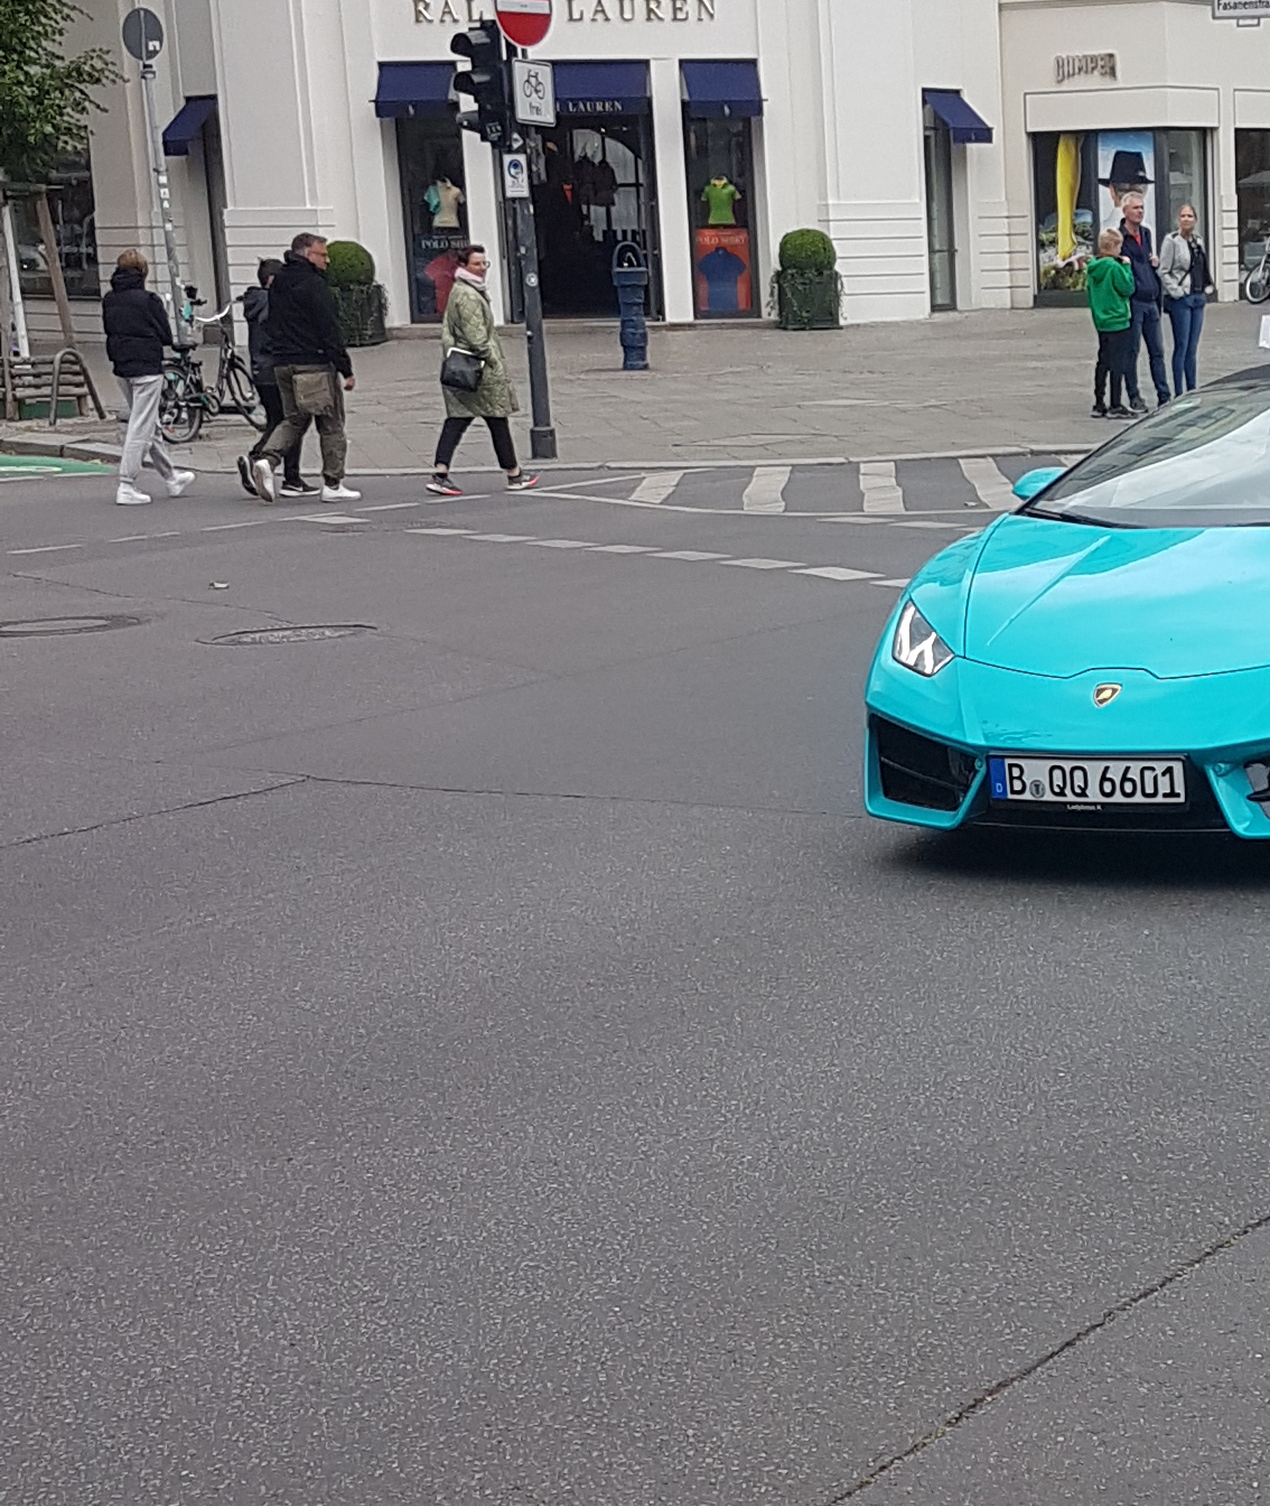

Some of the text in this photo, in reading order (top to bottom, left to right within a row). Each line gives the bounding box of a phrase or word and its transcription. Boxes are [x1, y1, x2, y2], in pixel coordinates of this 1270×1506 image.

[568, 100, 623, 113] LAUREN
[1007, 763, 1027, 795] B
[1048, 765, 1091, 798] QQ
[1099, 766, 1181, 798] 6601
